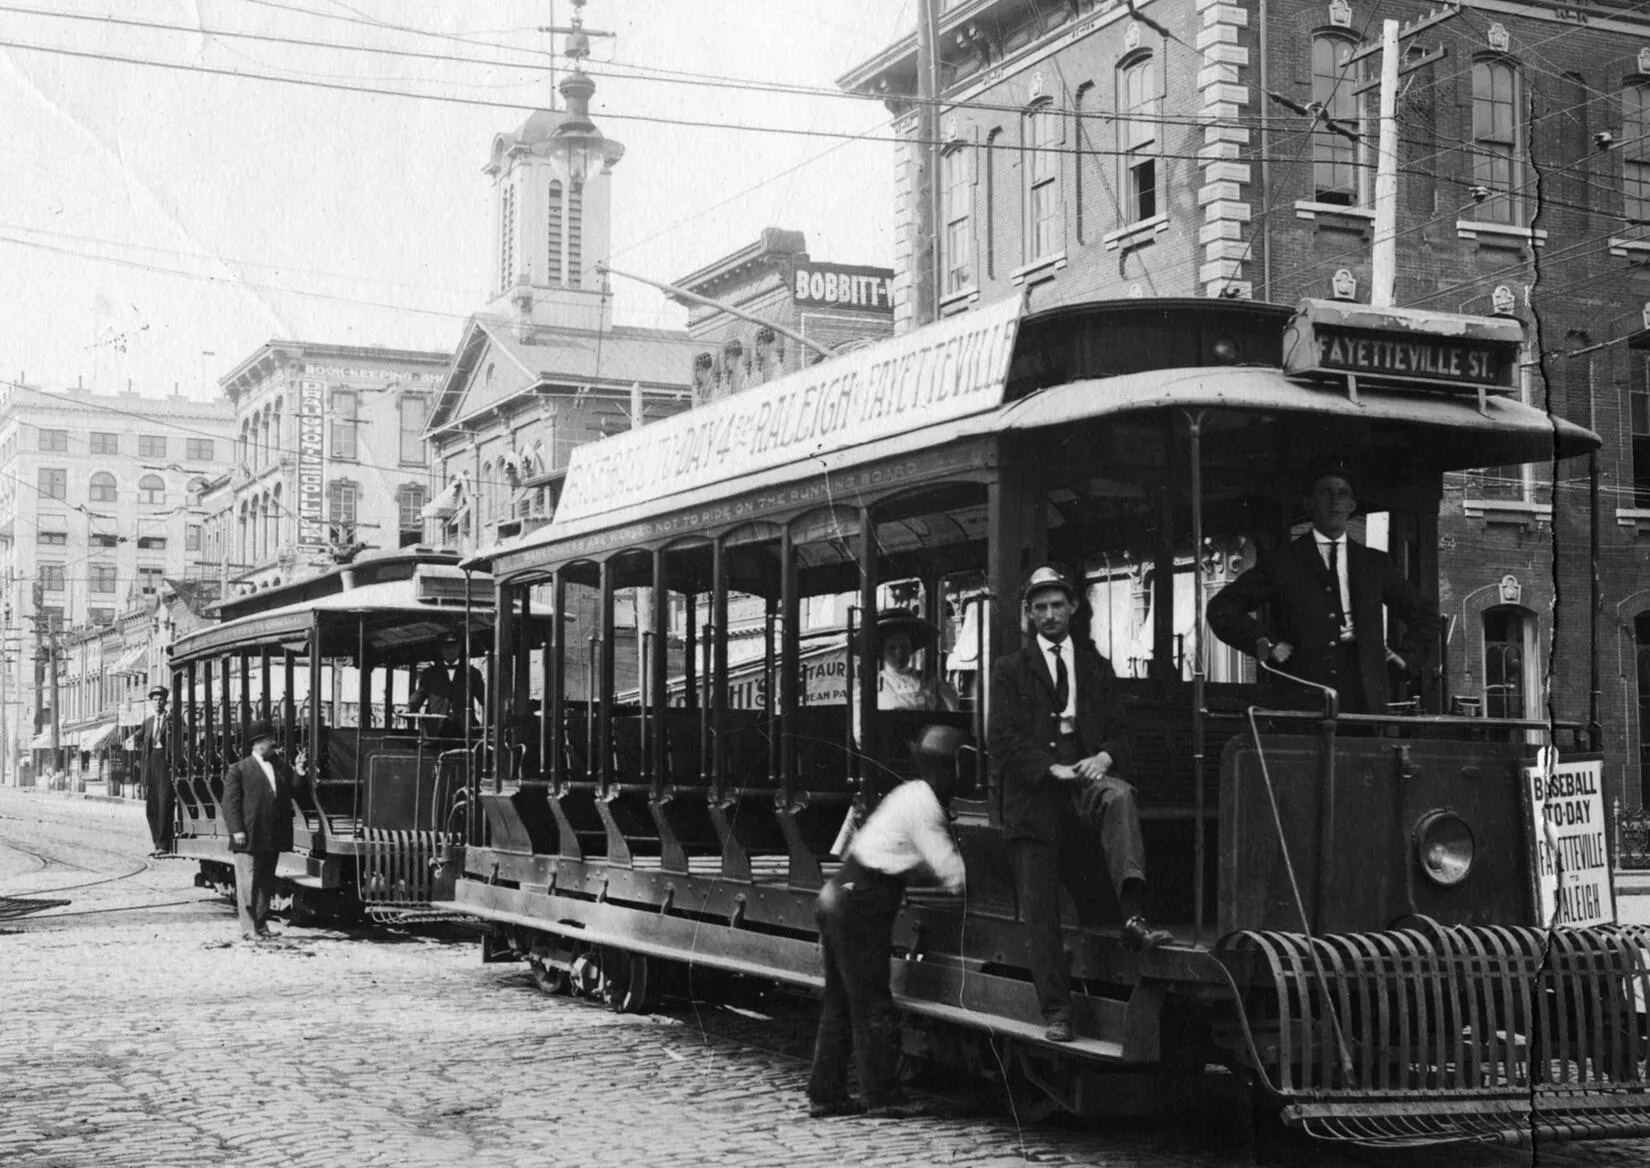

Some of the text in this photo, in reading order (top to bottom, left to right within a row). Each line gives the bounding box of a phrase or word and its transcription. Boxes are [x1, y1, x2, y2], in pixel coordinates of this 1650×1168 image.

[1317, 334, 1495, 379] FAYETTEVILLE ST.
[750, 371, 857, 454] RALEIGH
[860, 318, 1018, 423] FAYETTEVILLE
[654, 517, 679, 533] NOT
[683, 513, 698, 529] TO
[702, 506, 731, 524] RIDE
[735, 500, 755, 515] ON
[759, 491, 785, 508] THE
[790, 474, 856, 502] RUNNING
[860, 461, 917, 485] BOARD
[1533, 771, 1598, 801] BASEBALL
